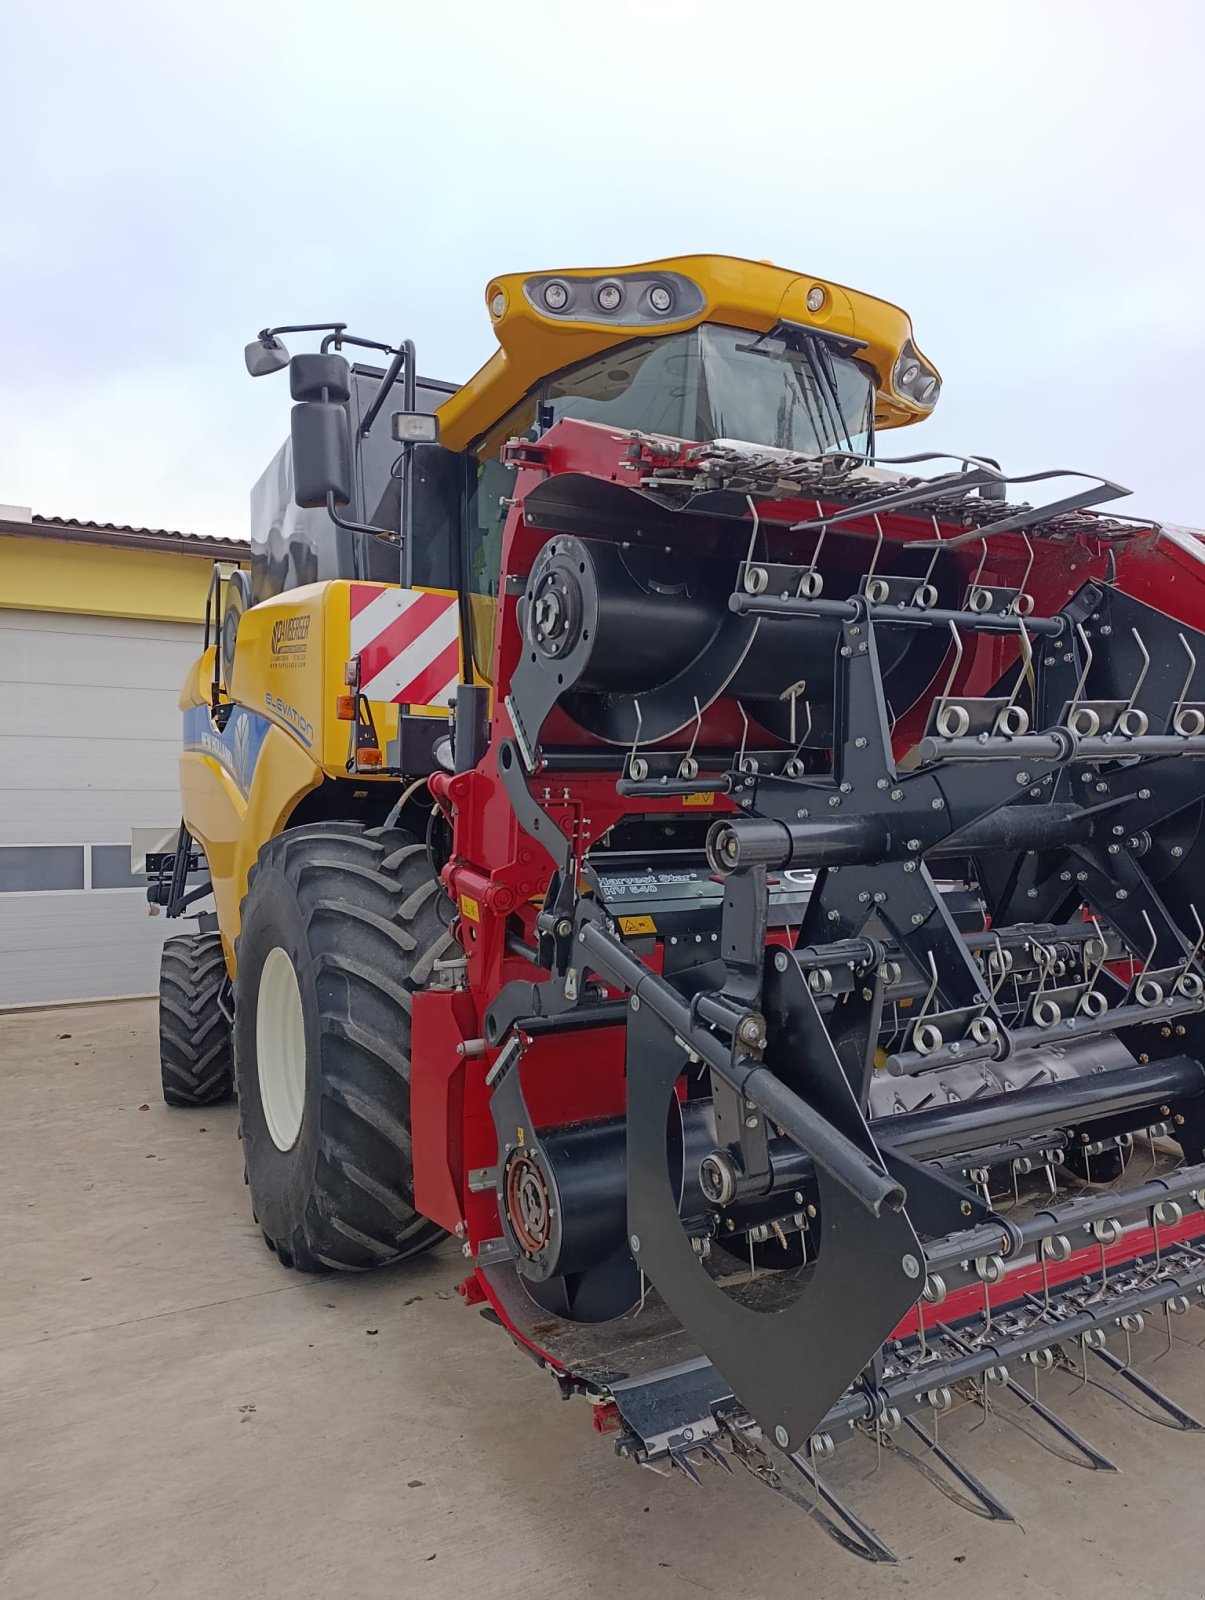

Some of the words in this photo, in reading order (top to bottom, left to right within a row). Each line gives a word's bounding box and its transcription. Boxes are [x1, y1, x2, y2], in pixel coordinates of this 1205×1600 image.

[265, 691, 314, 741] ELEVATION
[598, 875, 658, 887] Harvest
[603, 886, 626, 895] HV
[629, 884, 658, 894] 540
